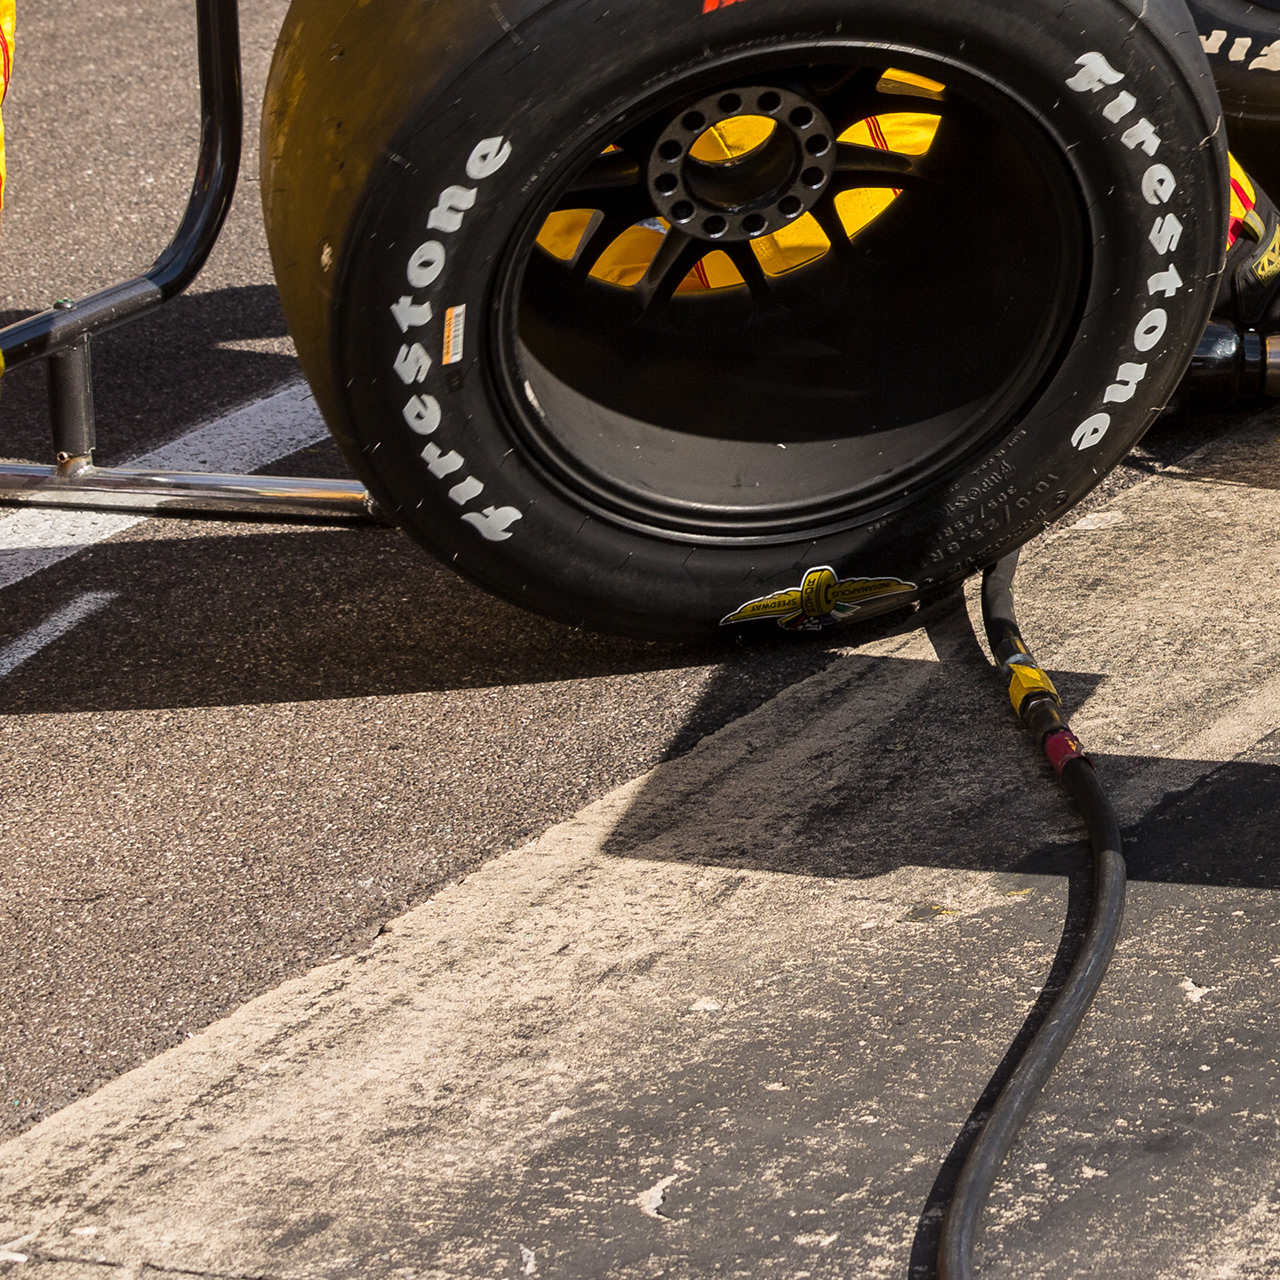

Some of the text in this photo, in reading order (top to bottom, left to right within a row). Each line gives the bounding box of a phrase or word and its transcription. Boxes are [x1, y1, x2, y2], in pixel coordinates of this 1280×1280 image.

[1064, 51, 1184, 451] Firestone
[389, 135, 523, 542] Firestone
[750, 597, 798, 613] SPEEDWAY
[804, 577, 816, 614] MOTOR
[831, 581, 891, 600] INDIANAPOLIS
